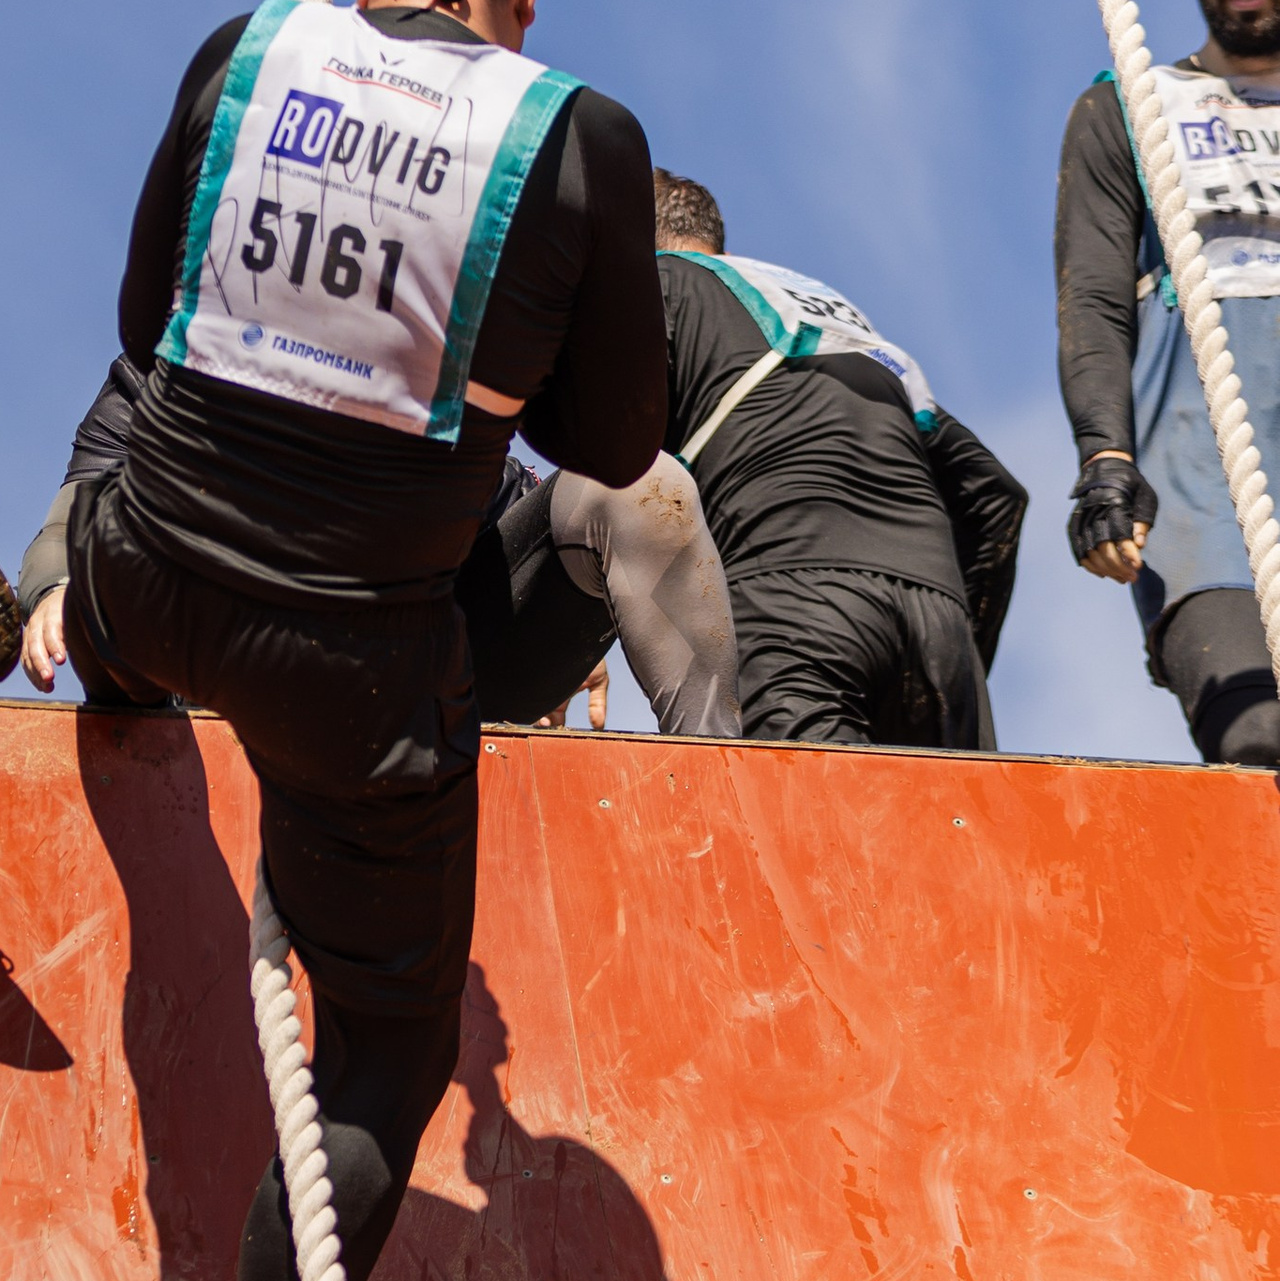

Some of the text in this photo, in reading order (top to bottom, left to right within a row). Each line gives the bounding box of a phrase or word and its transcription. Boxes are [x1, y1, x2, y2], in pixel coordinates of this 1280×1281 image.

[327, 56, 443, 104] ГОНКА ГЕРОЕВ
[272, 97, 452, 196] RODVIG
[240, 197, 404, 314] 5161
[271, 334, 375, 380] ГАЗПРОМБАНК
